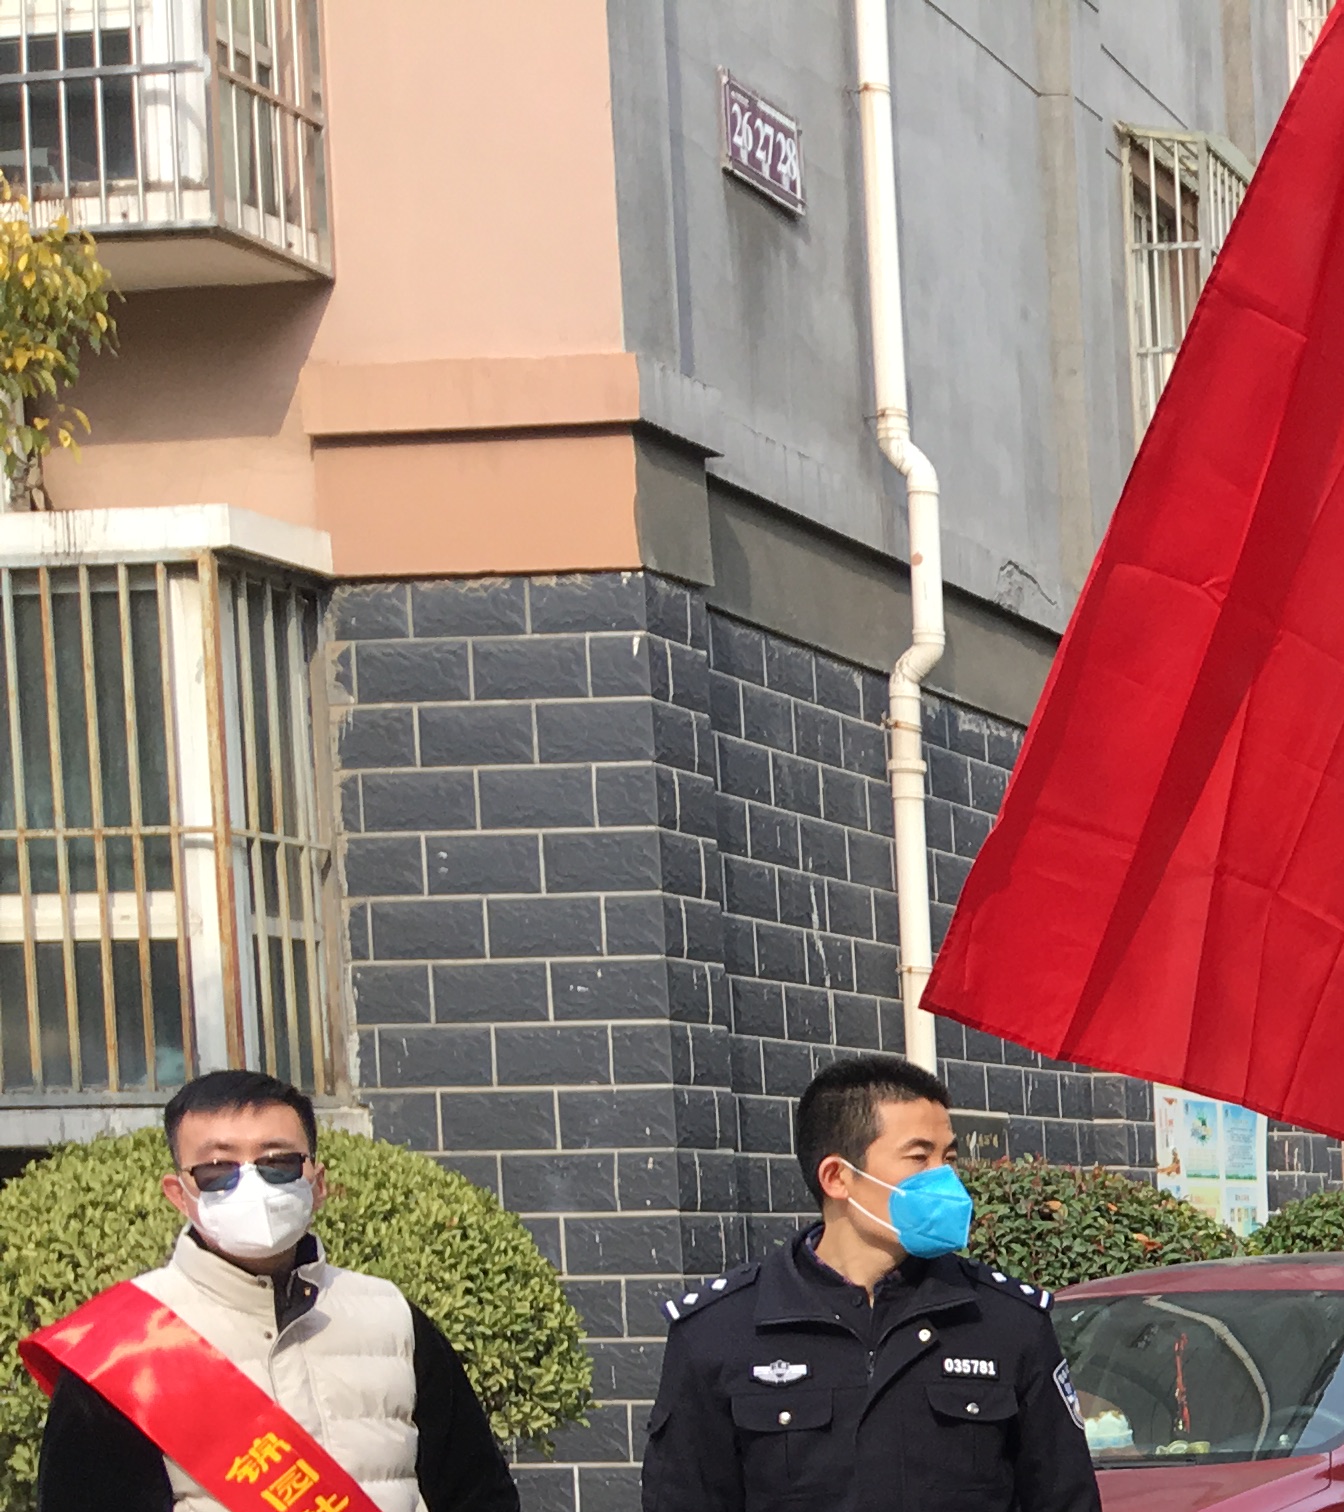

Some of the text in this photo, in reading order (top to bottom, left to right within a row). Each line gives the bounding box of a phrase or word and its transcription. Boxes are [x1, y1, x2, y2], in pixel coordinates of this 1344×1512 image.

[732, 103, 753, 151] 26
[754, 118, 774, 165] 27
[776, 132, 797, 179] 28
[944, 1358, 996, 1376] 035781
